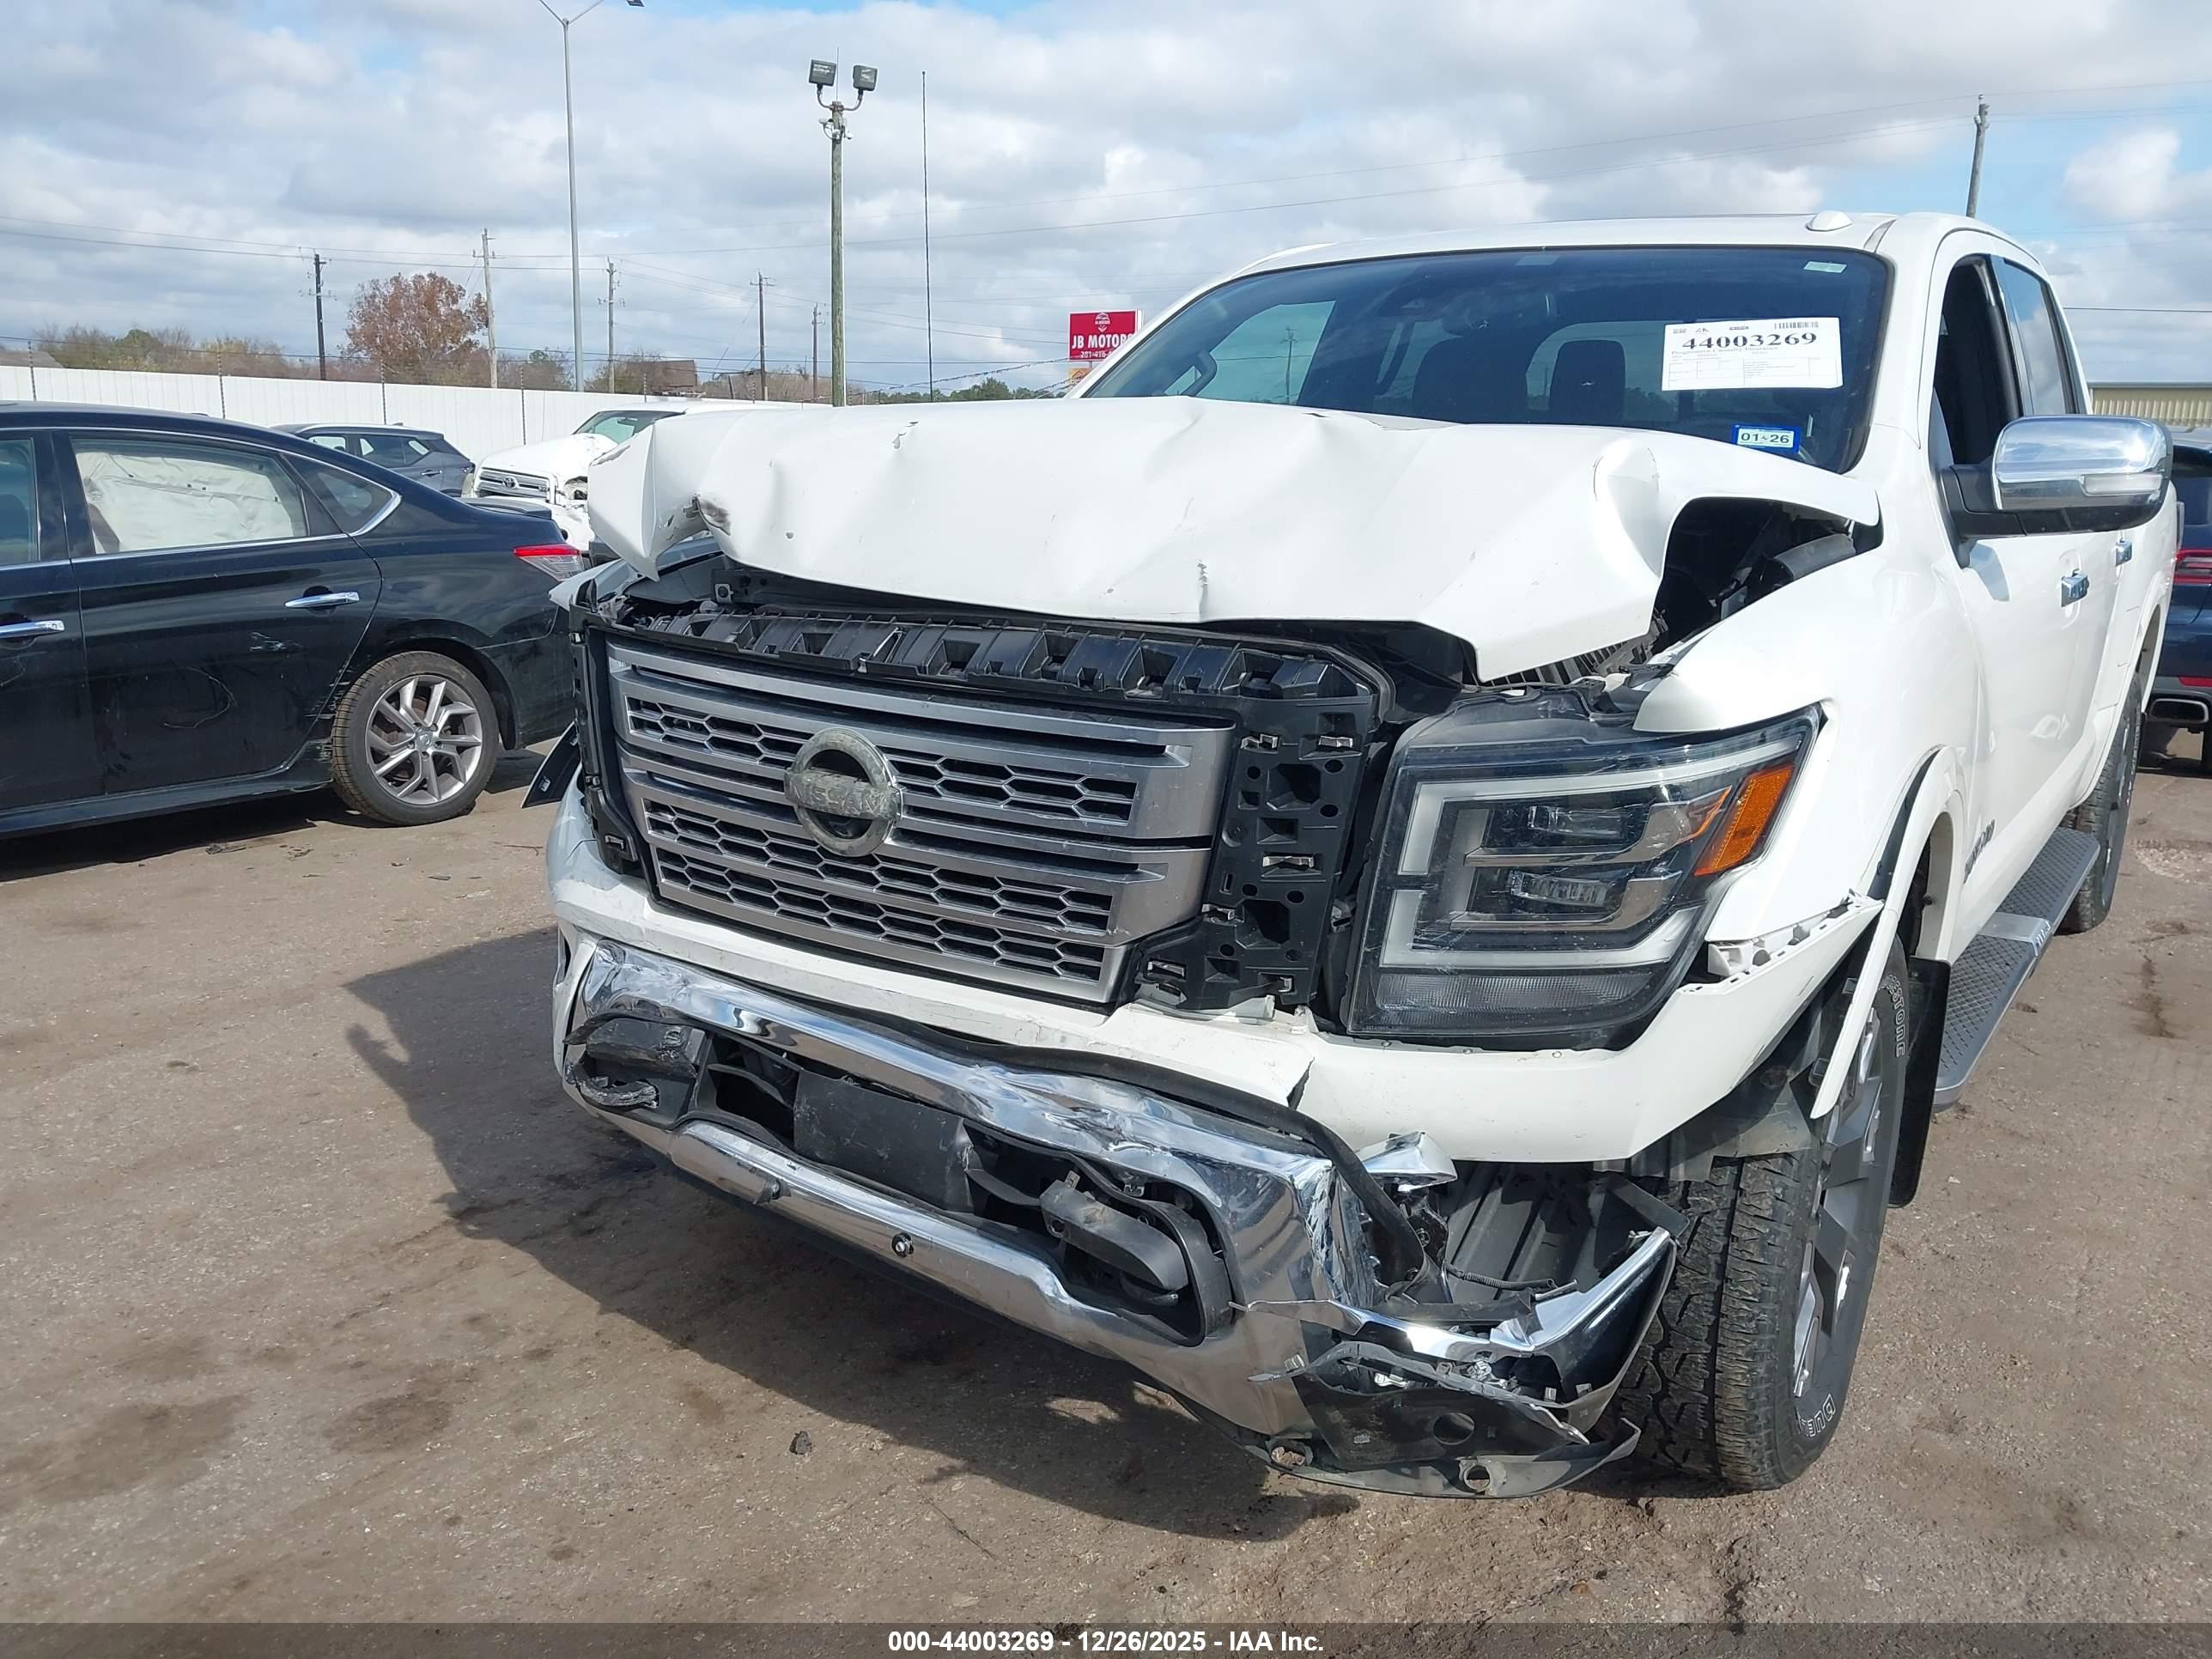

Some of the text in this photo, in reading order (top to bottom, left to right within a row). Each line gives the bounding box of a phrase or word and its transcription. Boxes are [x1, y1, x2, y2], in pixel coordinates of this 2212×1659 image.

[1072, 335, 1085, 349] JB
[1682, 332, 1816, 349] 44003269
[1741, 433, 1790, 443] 01 26
